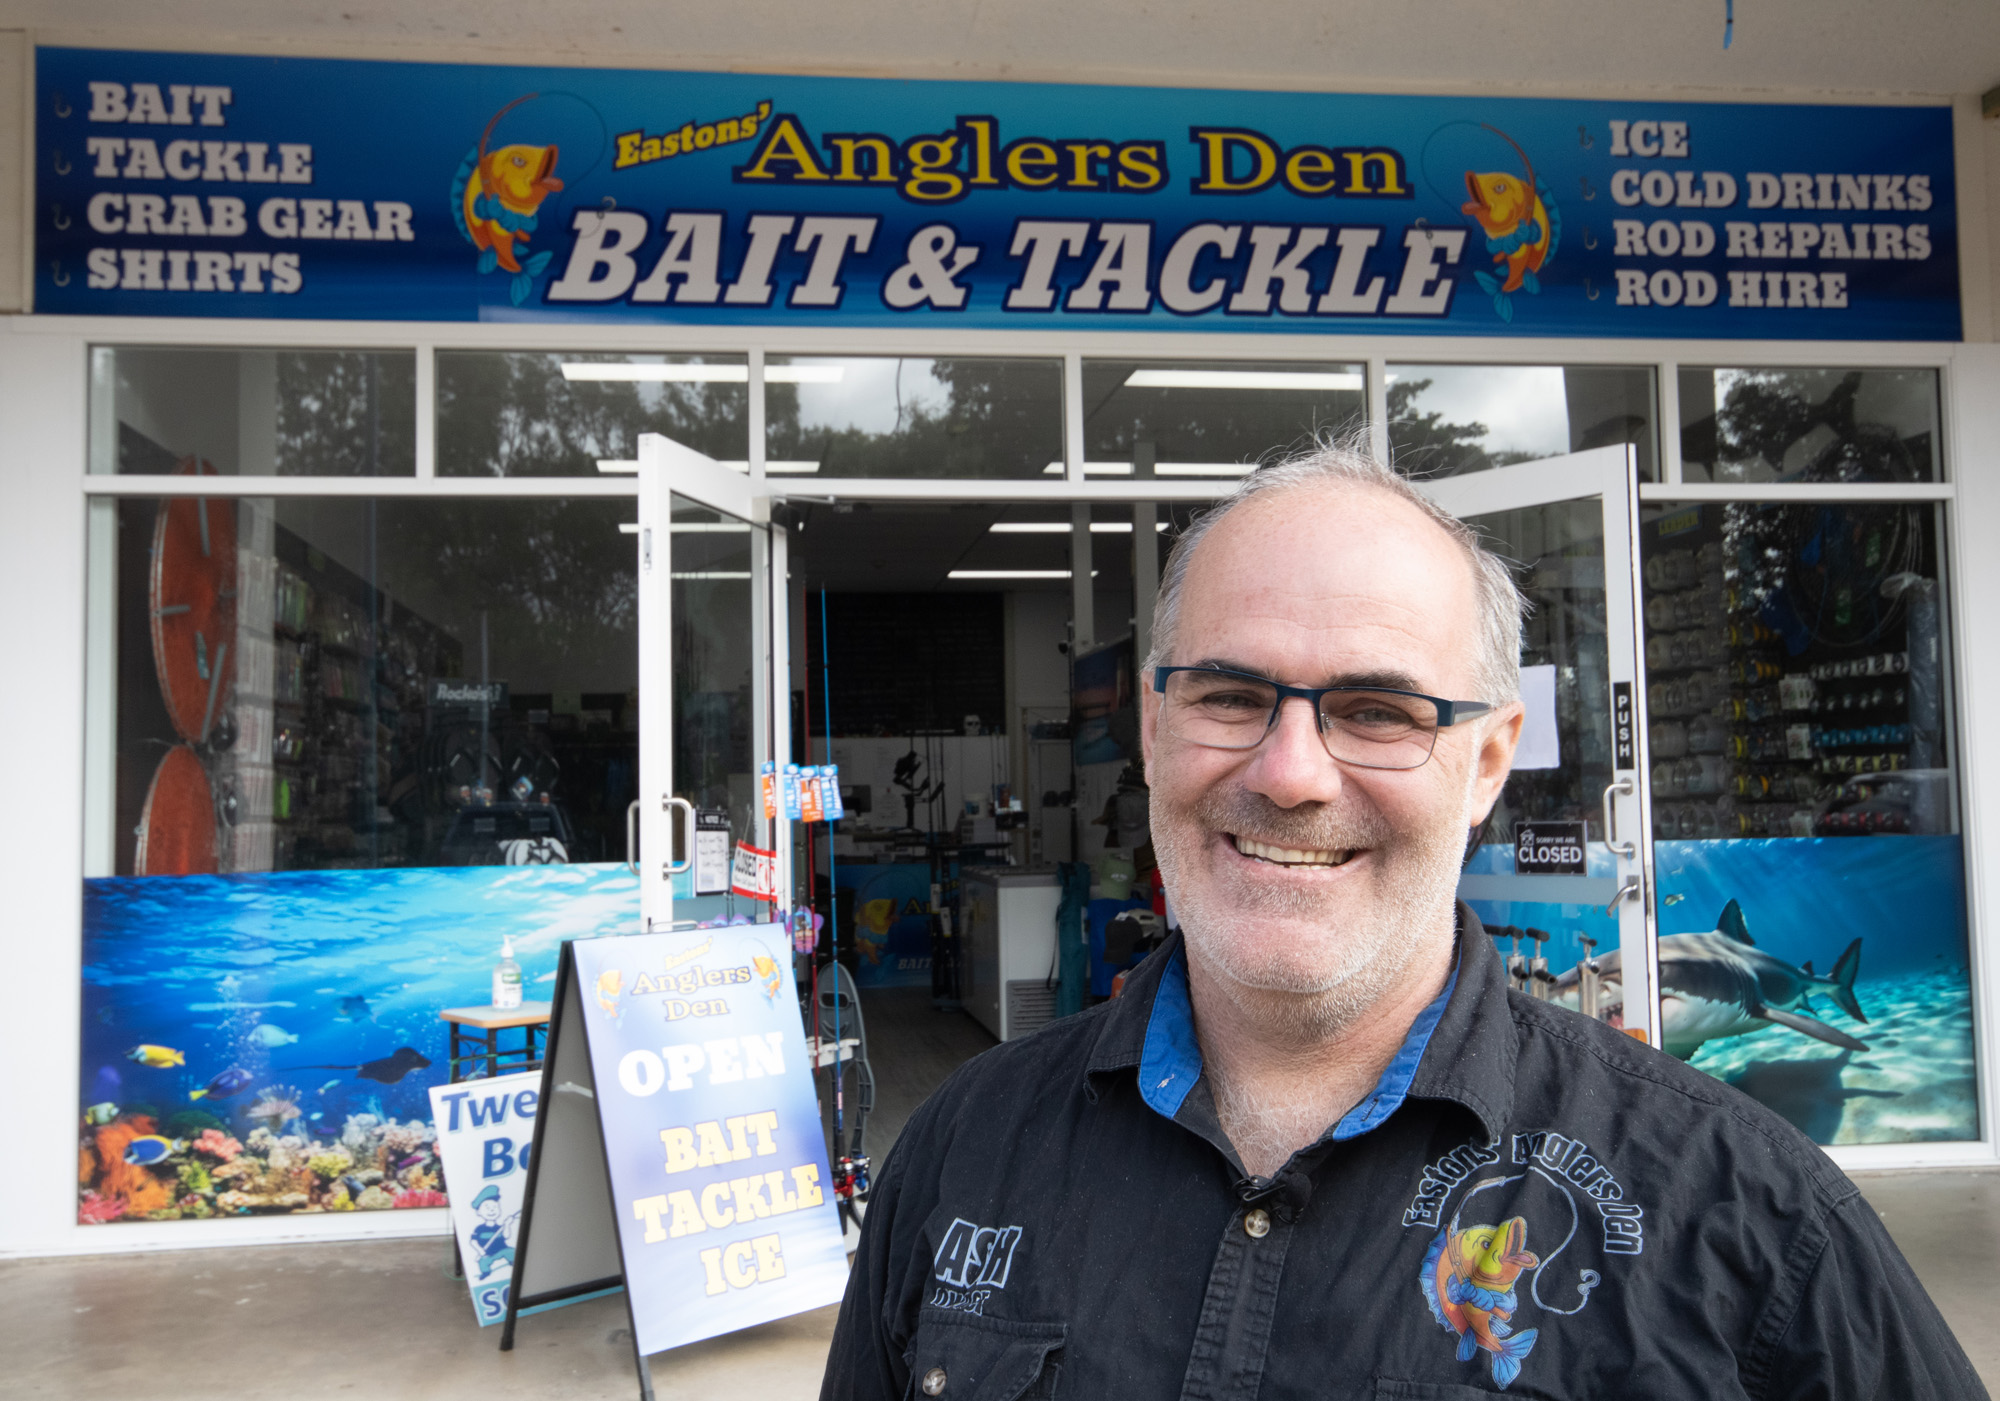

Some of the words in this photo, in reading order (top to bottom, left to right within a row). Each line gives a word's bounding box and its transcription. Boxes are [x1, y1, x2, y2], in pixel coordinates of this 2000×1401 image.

[88, 81, 232, 127] BAIT
[87, 137, 313, 185] TACKLE
[741, 119, 1163, 200] Anglers
[1198, 131, 1406, 195] Den
[1609, 119, 1689, 158] ICE
[1610, 169, 1738, 208] COLD
[1747, 172, 1933, 211] DRINKS
[86, 193, 248, 238] CRAB
[258, 197, 415, 241] GEAR
[1613, 219, 1716, 257] ROD
[1725, 221, 1932, 260] REPAIRS
[87, 248, 303, 294] SHIRTS
[546, 209, 879, 306] BAIT
[884, 224, 980, 308] &
[1007, 220, 1467, 315] TACKLE
[1615, 269, 1718, 307] ROD
[1727, 271, 1848, 308] HIRE
[1617, 694, 1630, 758] PUSH
[1518, 846, 1582, 863] CLOSED
[631, 964, 752, 997] Anglers
[664, 998, 730, 1022] Den
[618, 1031, 786, 1098] OPEN
[660, 1109, 778, 1175] BAIT
[632, 1162, 824, 1245] TACKLE
[1512, 1131, 1623, 1200] Anglers
[1597, 1202, 1643, 1255] Den
[699, 1232, 787, 1298] ICE
[934, 1217, 1023, 1289] ASH
